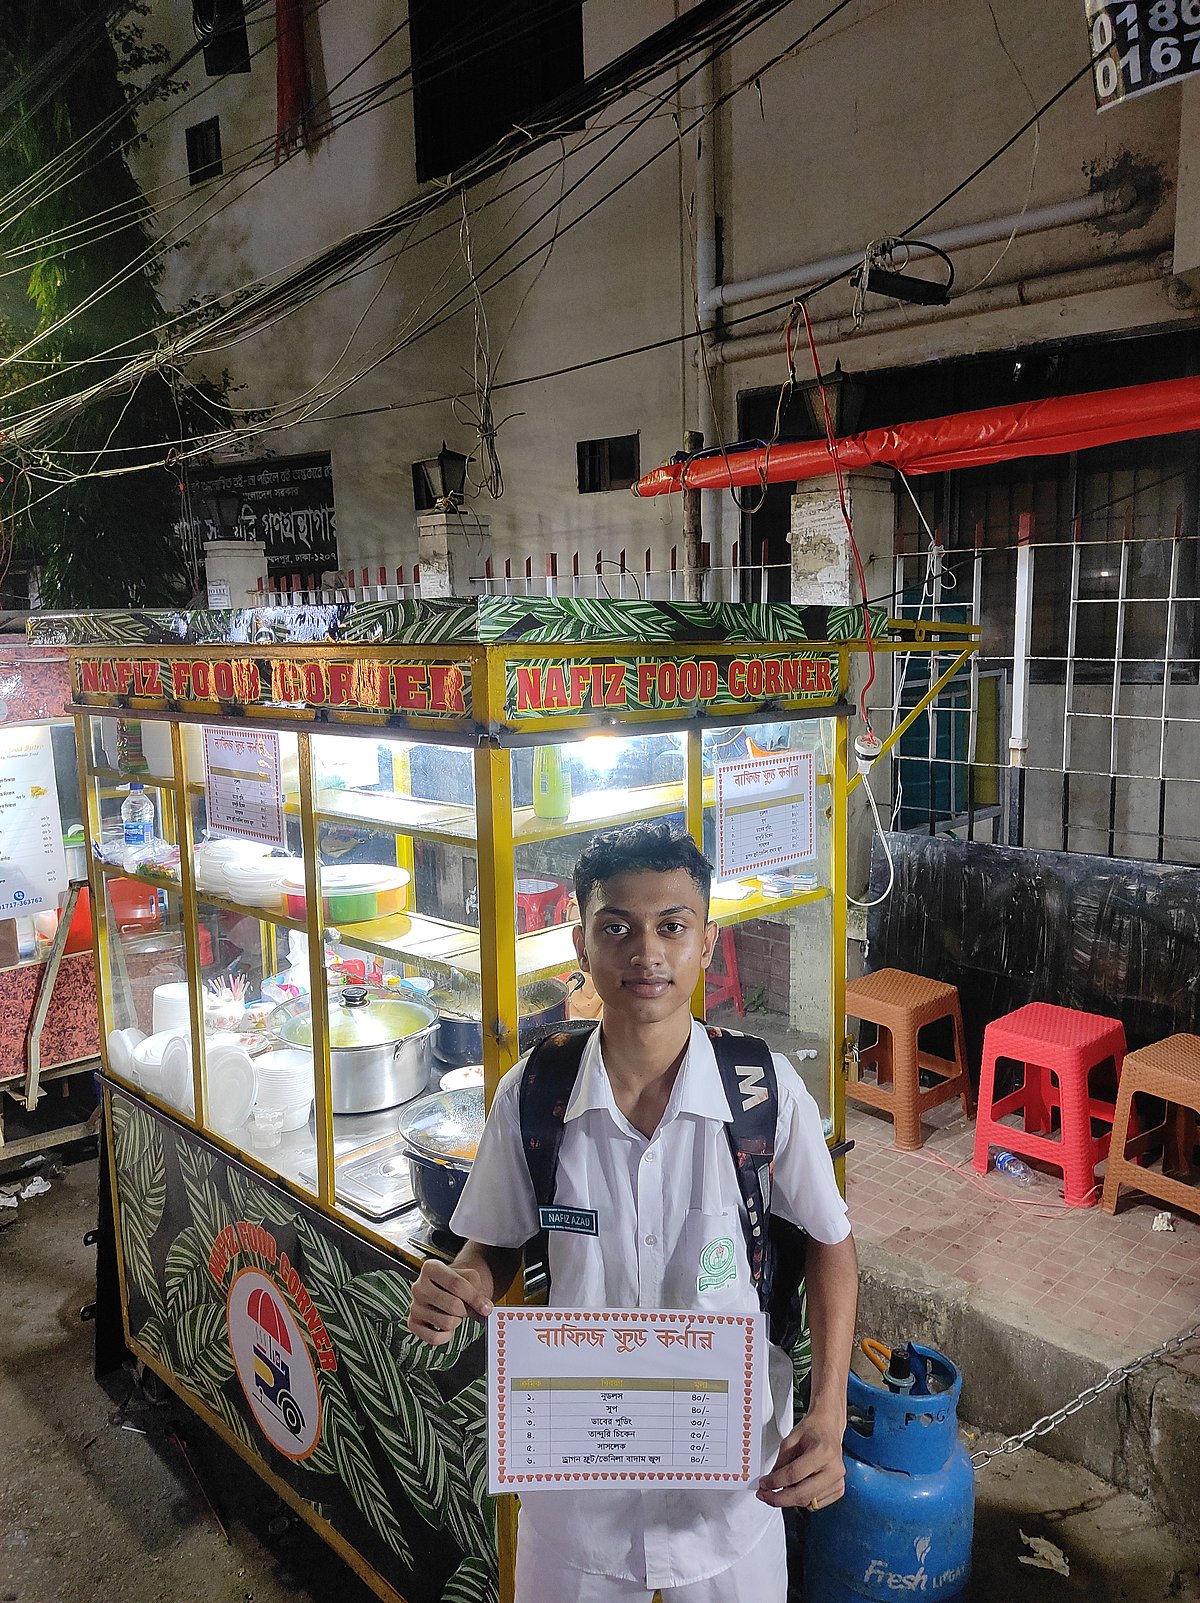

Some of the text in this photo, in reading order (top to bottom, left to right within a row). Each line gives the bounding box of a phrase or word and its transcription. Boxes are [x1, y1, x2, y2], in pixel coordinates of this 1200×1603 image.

[80, 659, 163, 696] NAFIZ
[172, 659, 261, 703] FOOD
[516, 658, 833, 711] NAFIZ FOOD CORNER
[548, 1213, 570, 1224] NAFIZ
[236, 1221, 276, 1265] FOOD
[280, 1252, 338, 1372] CORNER
[533, 1324, 607, 1348] নাফিজ
[611, 1328, 648, 1352] ফুড
